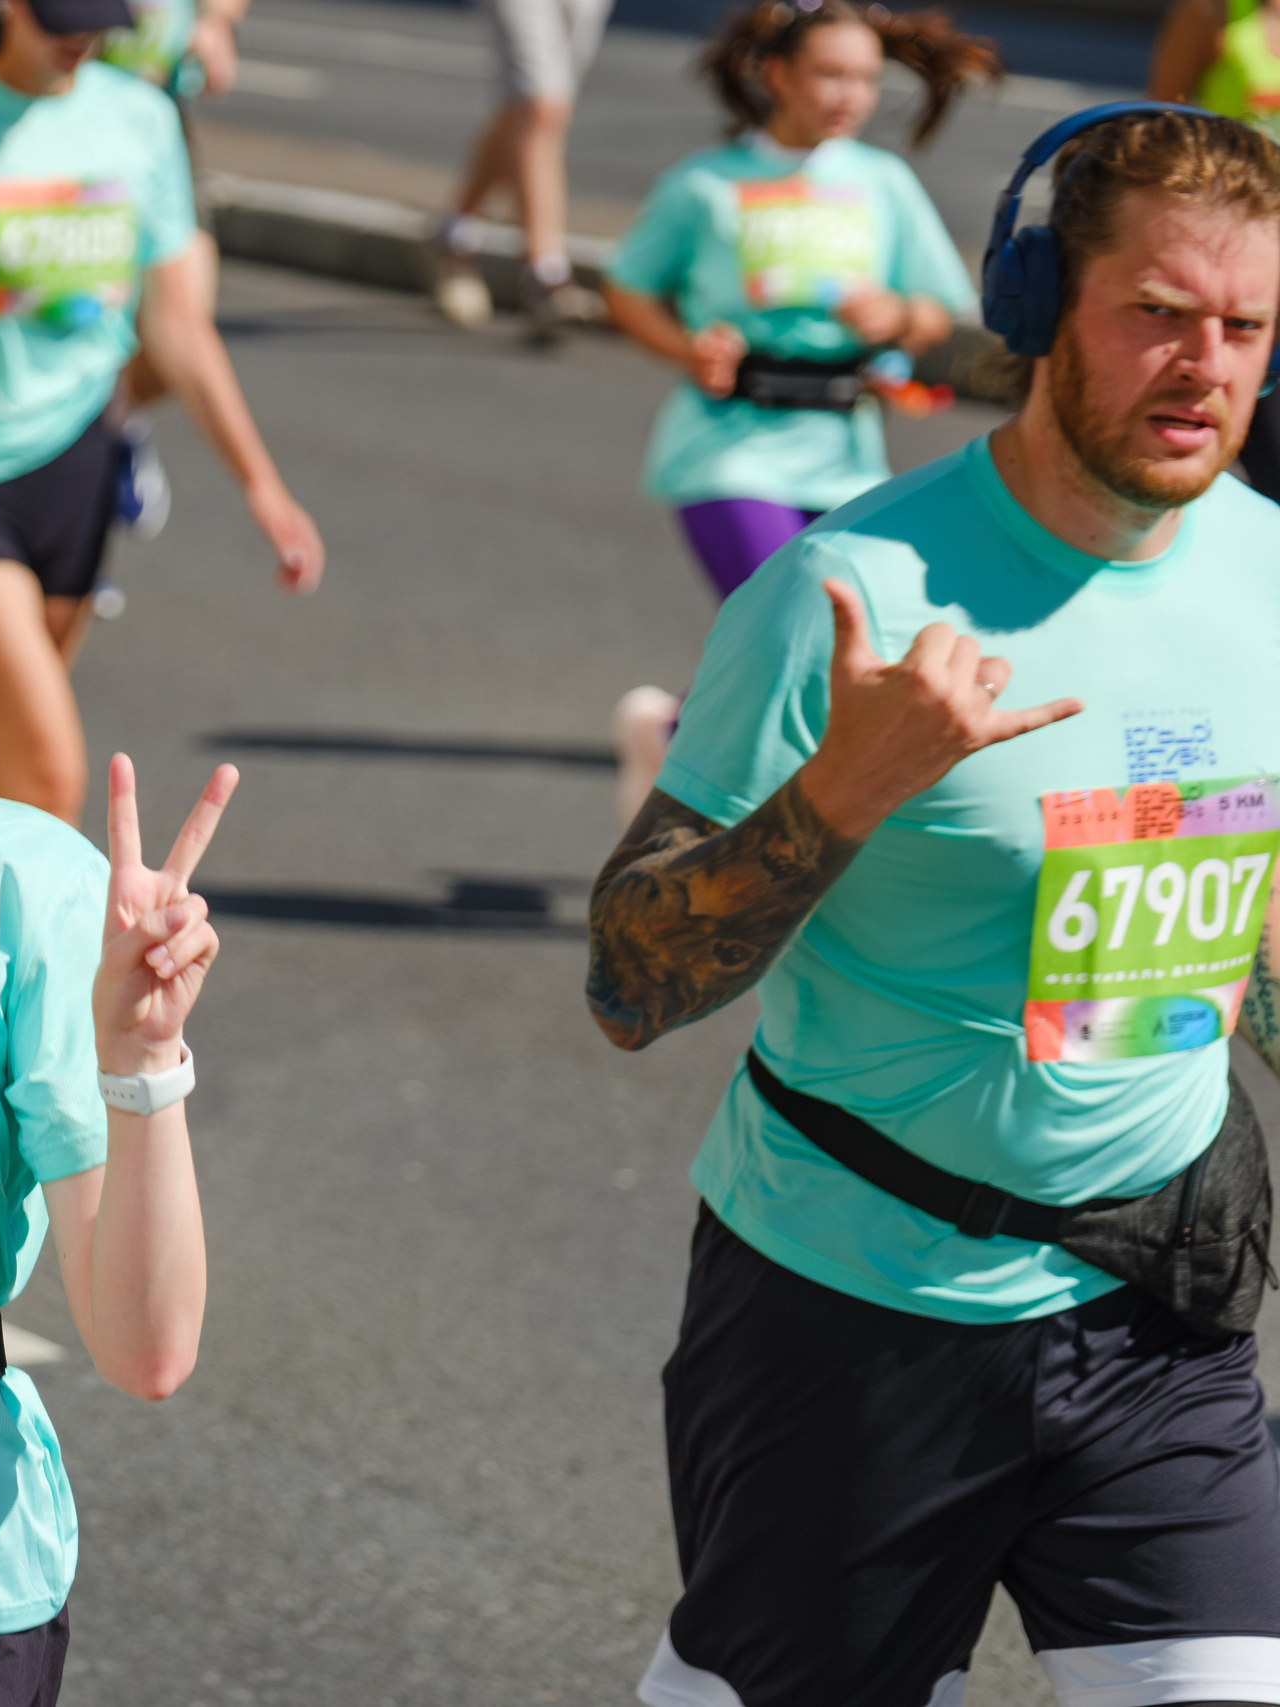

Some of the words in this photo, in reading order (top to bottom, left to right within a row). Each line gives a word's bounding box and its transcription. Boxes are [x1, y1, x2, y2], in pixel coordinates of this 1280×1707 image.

[1219, 796, 1232, 811] 5
[1046, 853, 1271, 953] 67907
[1044, 968, 1166, 985] ФЕСТИВАЛЬ
